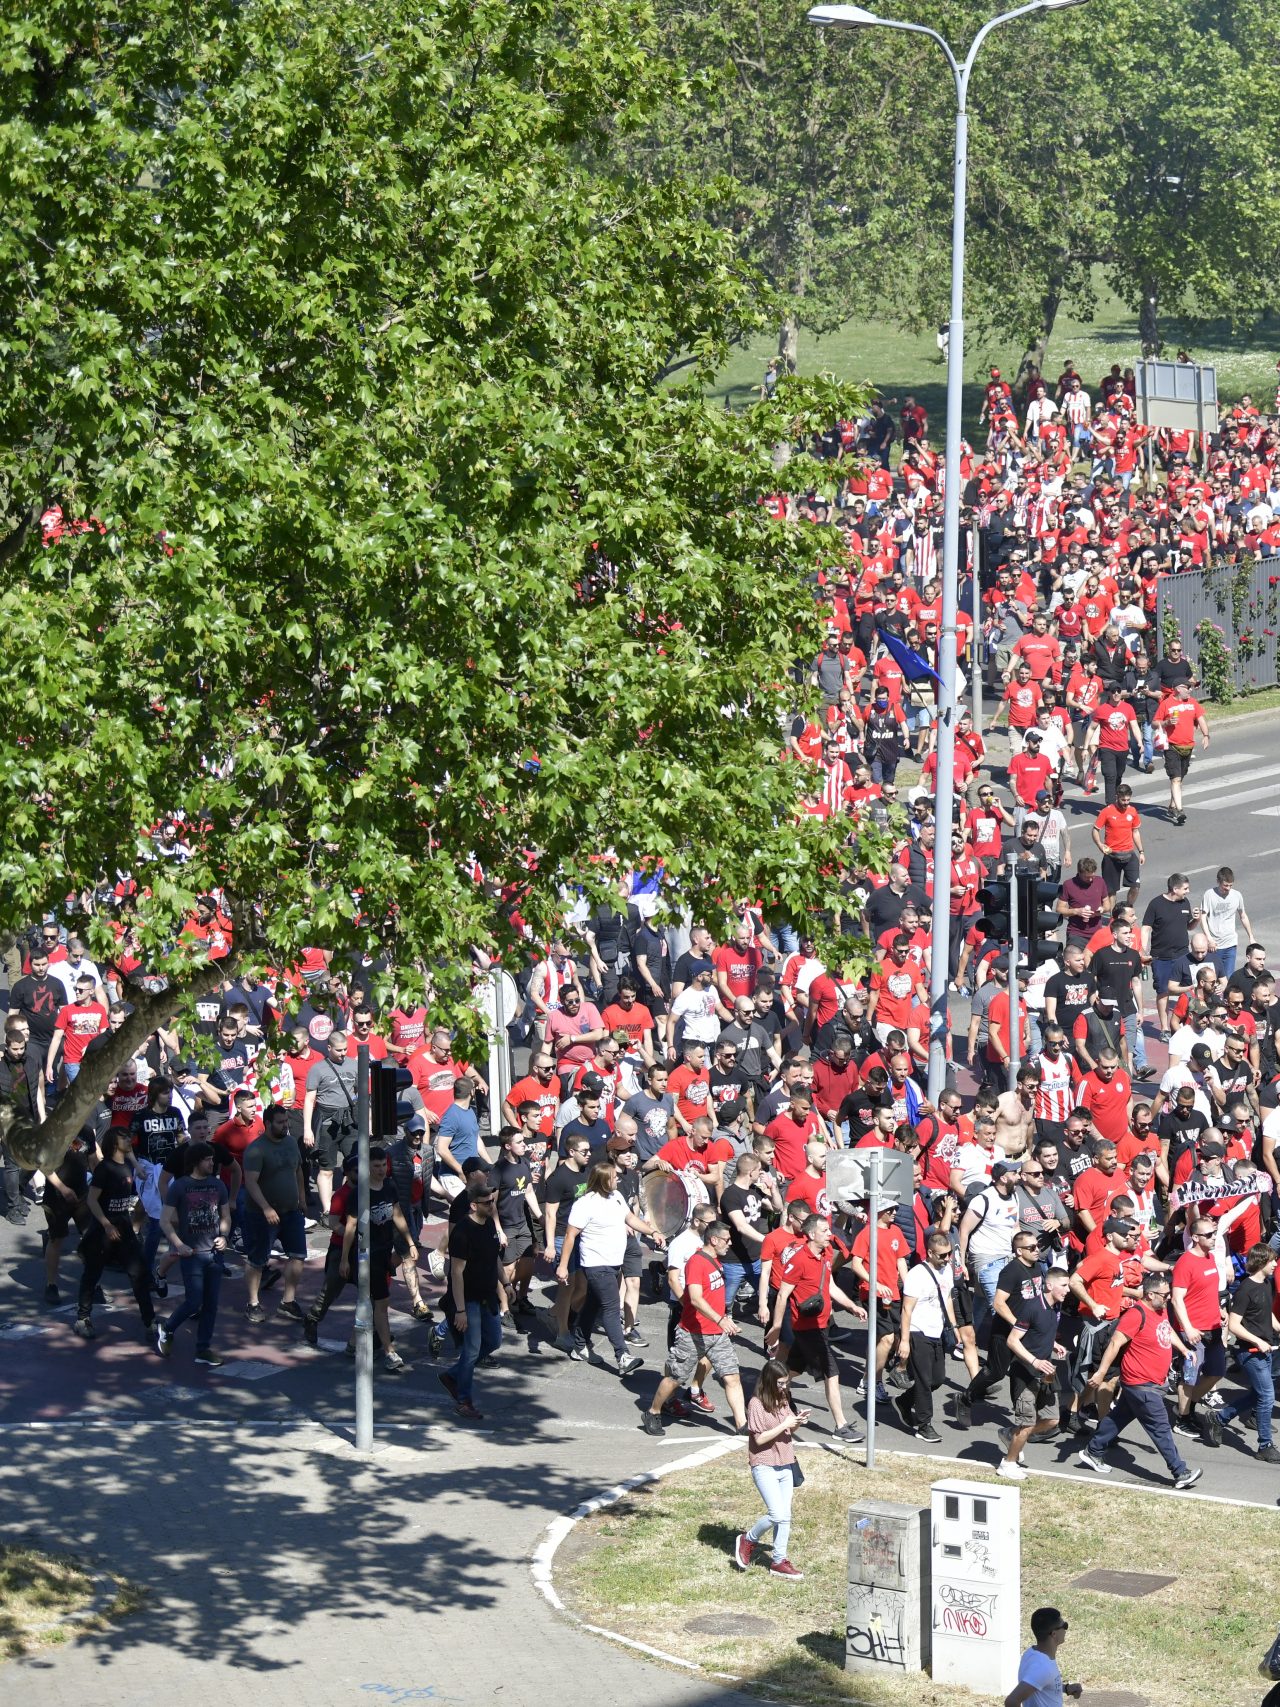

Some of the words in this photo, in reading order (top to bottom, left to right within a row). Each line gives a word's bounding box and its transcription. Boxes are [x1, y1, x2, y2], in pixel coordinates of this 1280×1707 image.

[872, 730, 894, 739] bwin
[144, 1117, 178, 1132] OSAKA
[1024, 1204, 1052, 1215] CRZY
[1024, 1212, 1055, 1223] NORH
